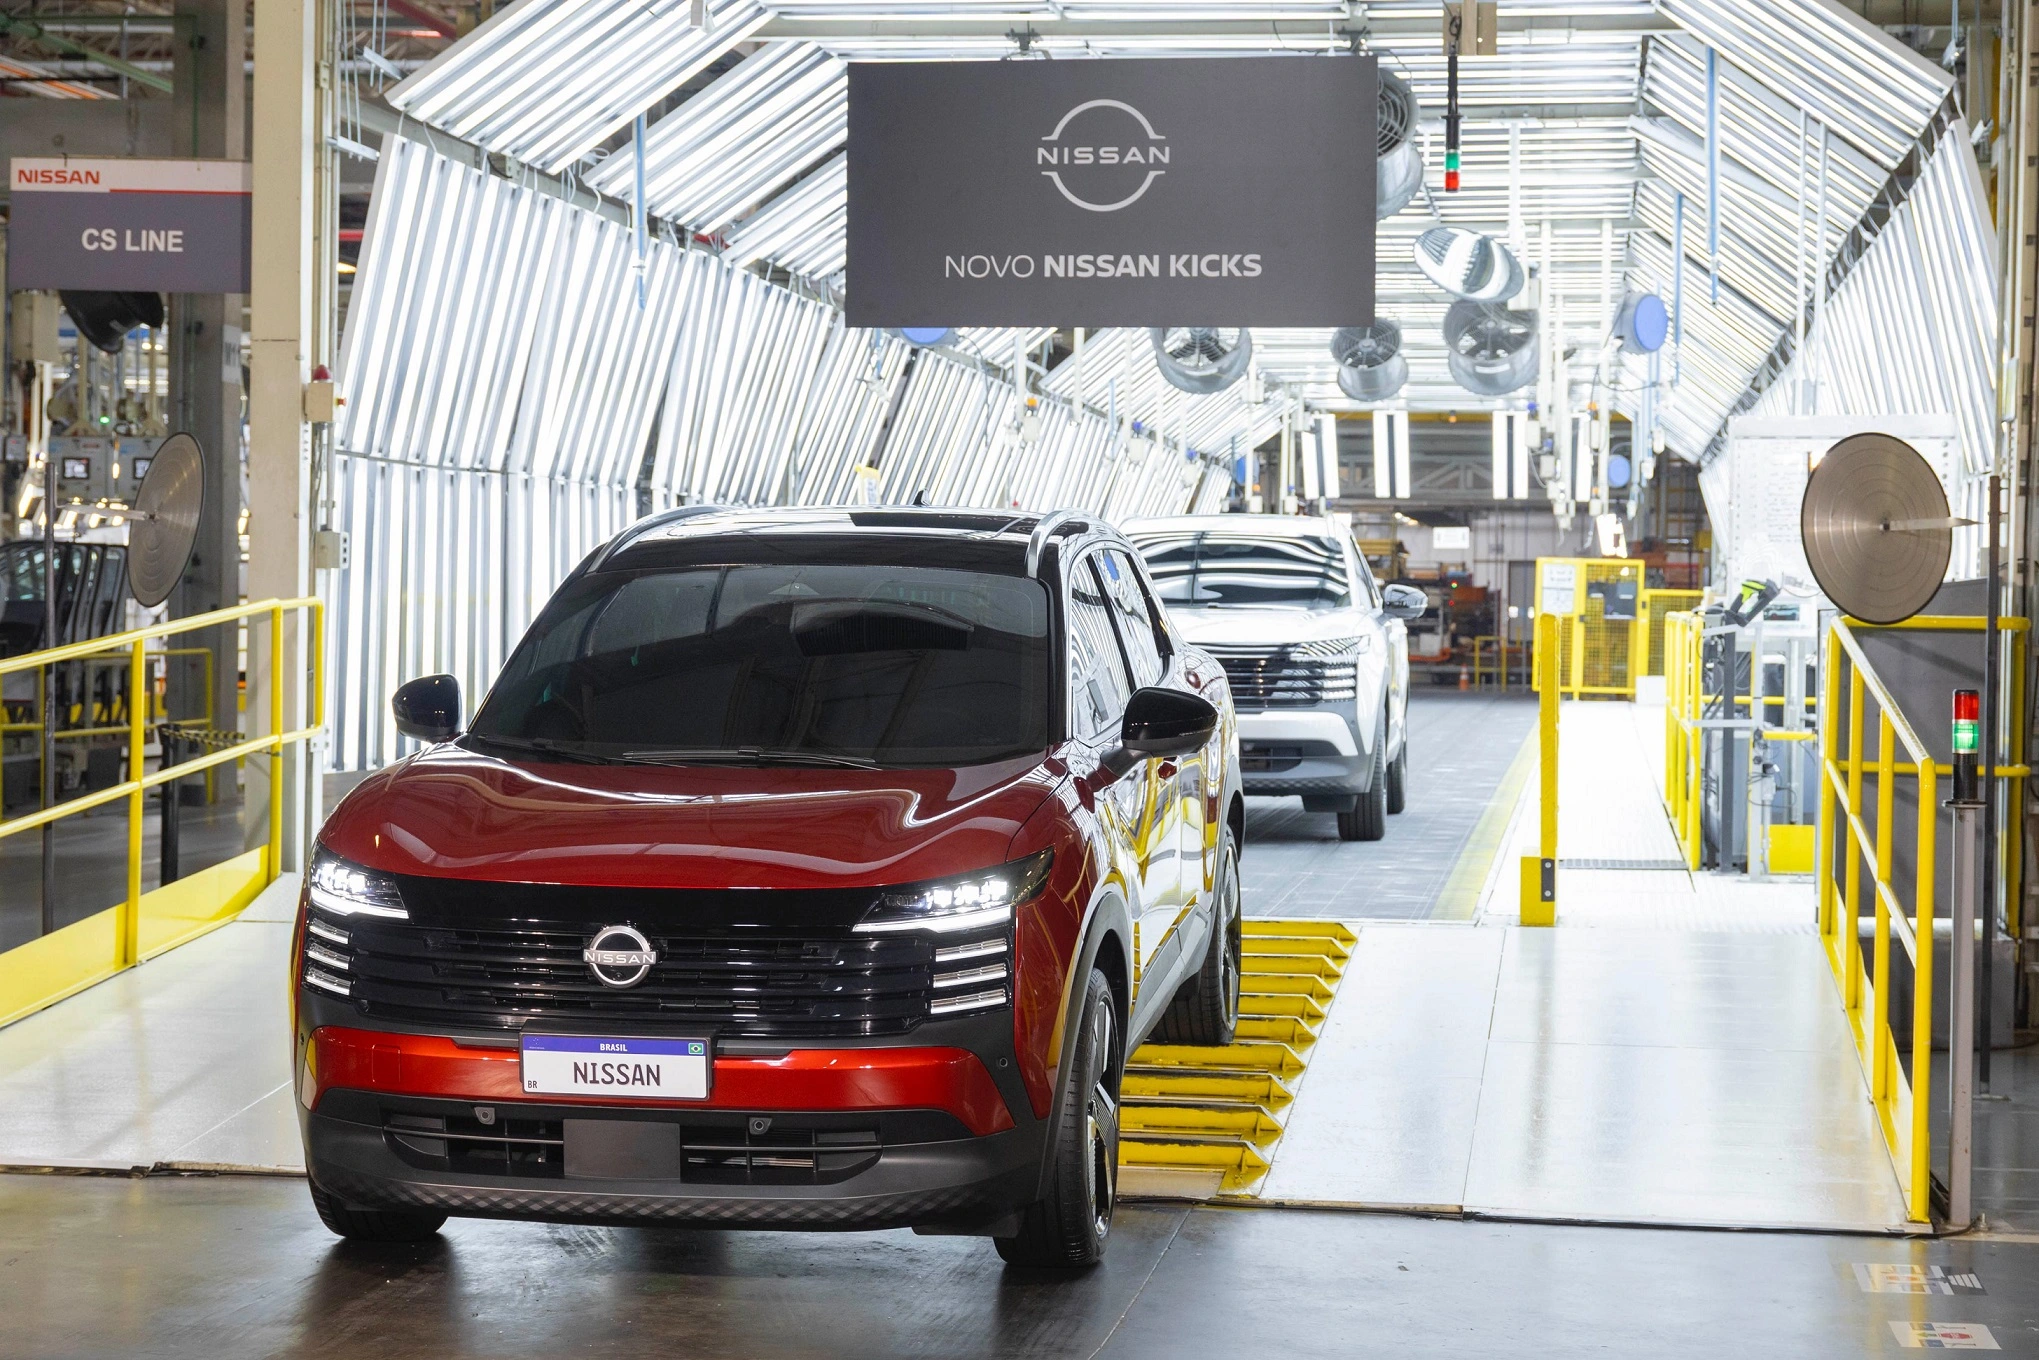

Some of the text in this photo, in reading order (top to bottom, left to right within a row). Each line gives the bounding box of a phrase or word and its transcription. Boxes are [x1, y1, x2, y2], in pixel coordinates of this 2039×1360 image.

[1037, 146, 1170, 165] NISSAN
[17, 169, 100, 185] NISSAN
[81, 229, 184, 253] CS LINE
[945, 254, 1263, 278] NOVO NISSAN KICKS
[585, 951, 654, 964] NISSAN
[599, 1043, 628, 1053] BRASIL
[573, 1061, 661, 1087] NISSAN
[527, 1080, 538, 1089] BR
